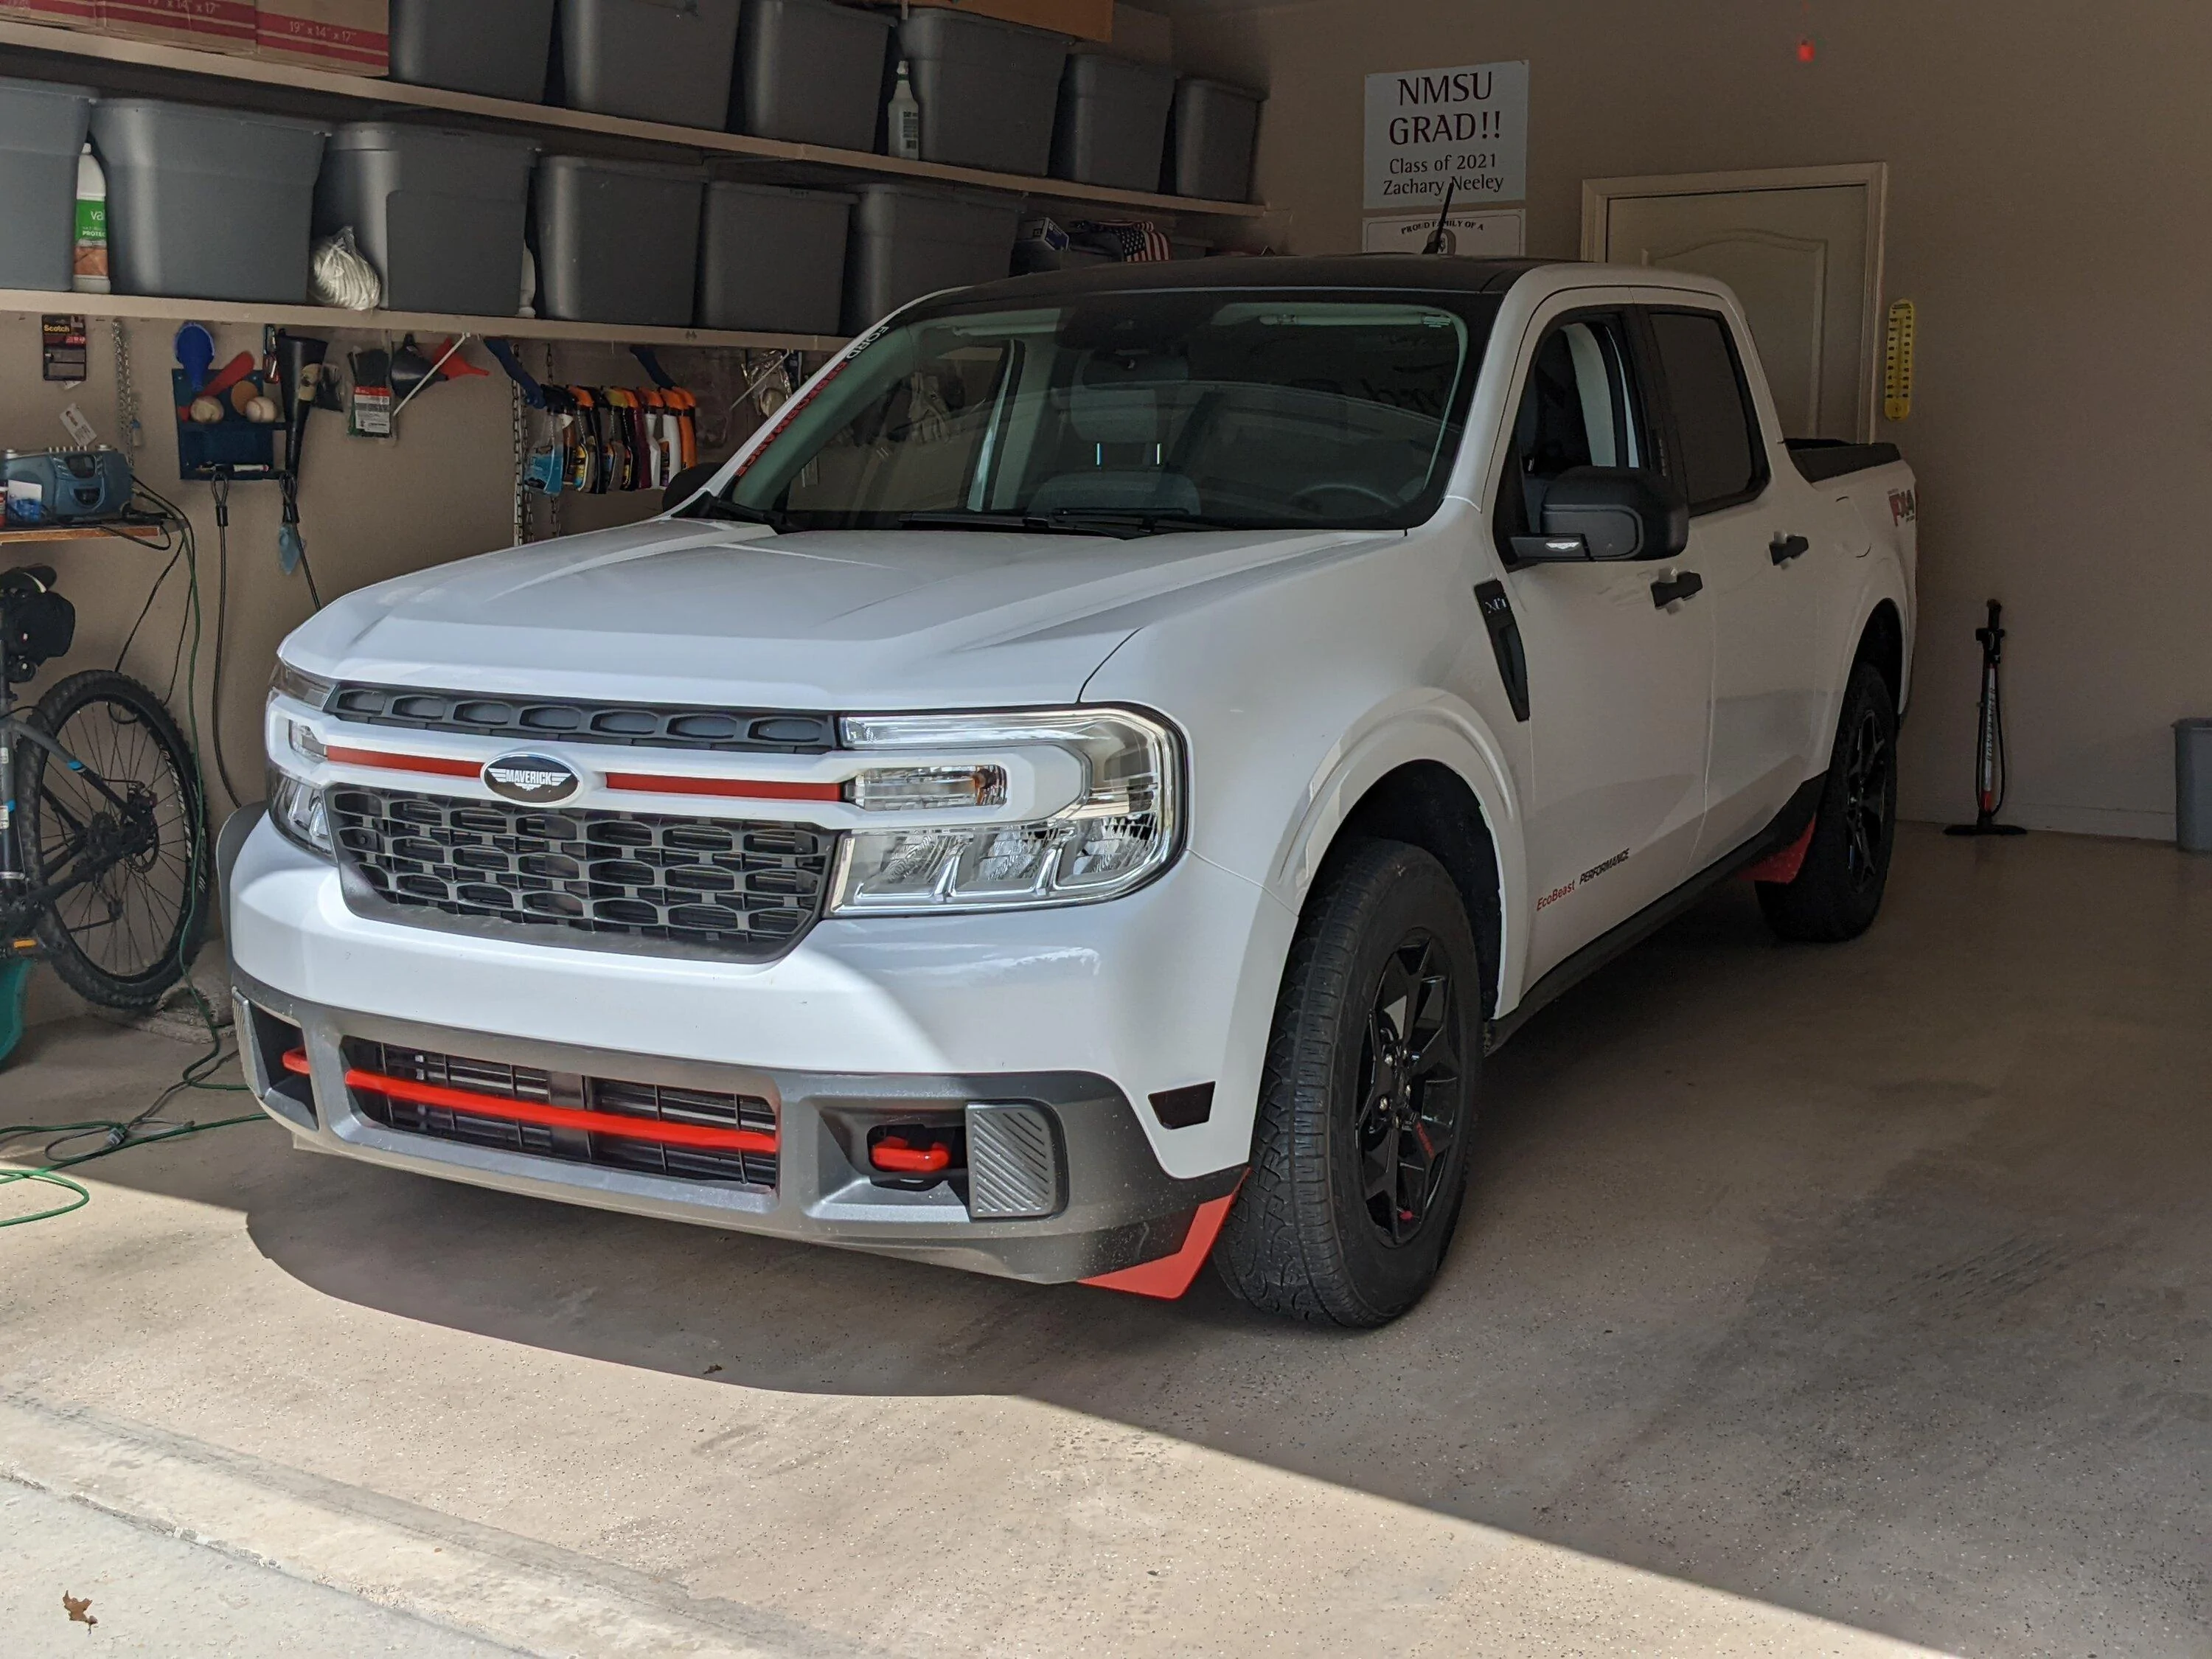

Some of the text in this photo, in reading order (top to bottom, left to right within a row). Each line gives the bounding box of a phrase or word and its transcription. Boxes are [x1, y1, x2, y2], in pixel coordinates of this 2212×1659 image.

[1397, 71, 1492, 105] NMSU
[1389, 111, 1500, 145] GRAD!!
[1389, 153, 1496, 174] Class of 2021
[1383, 173, 1504, 196] Zachary Neeley
[44, 324, 71, 333] Scotch
[846, 325, 889, 360] FORD
[505, 768, 552, 786] MAVERICK
[1536, 847, 1630, 912] EcoBeast PERFORMANCE
